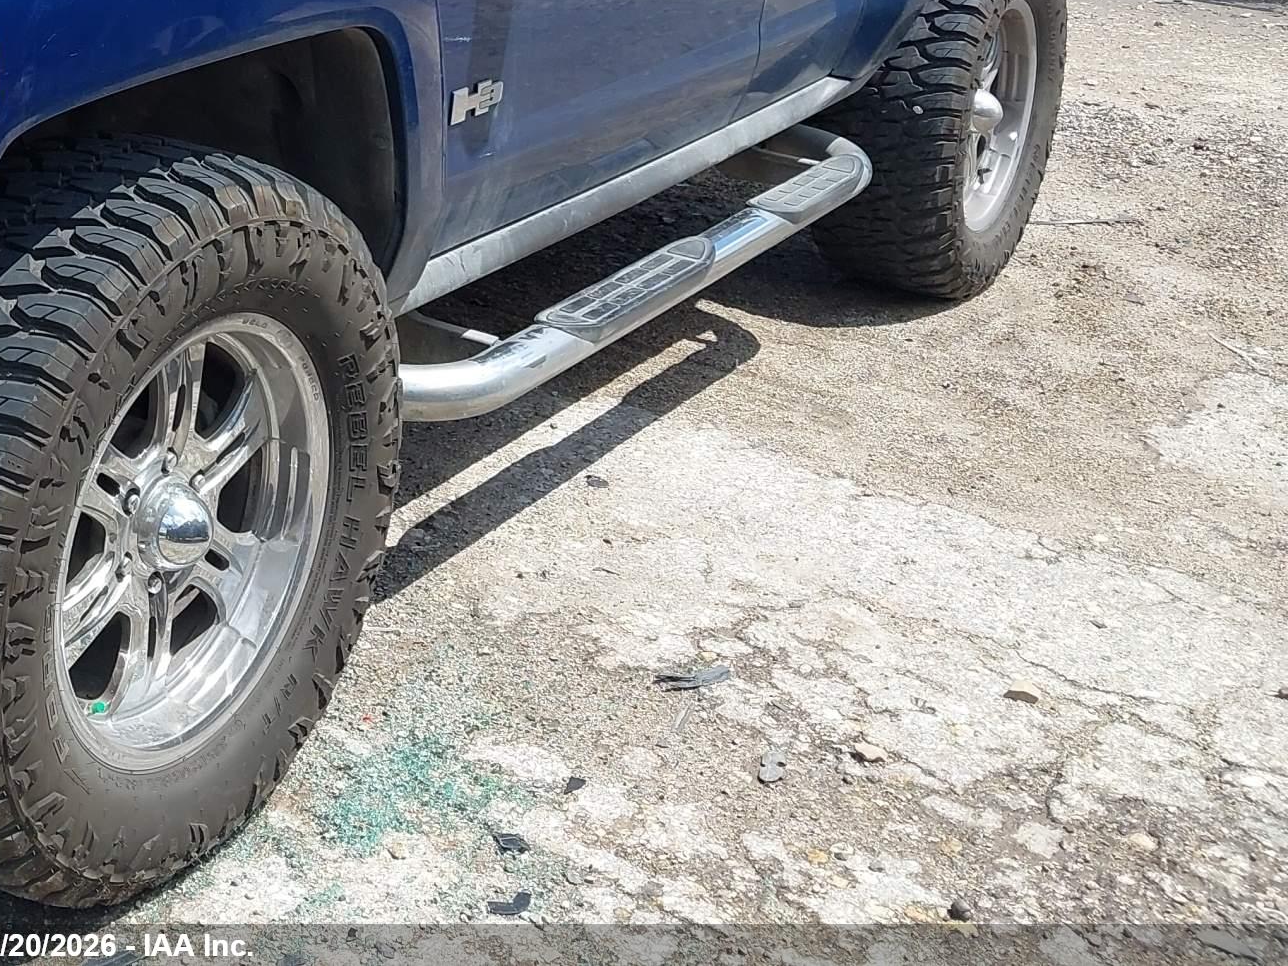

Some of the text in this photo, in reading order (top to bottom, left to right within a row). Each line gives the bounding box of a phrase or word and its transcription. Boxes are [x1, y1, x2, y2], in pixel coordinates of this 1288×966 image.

[450, 79, 504, 126] H3
[337, 353, 369, 503] REBEL
[301, 515, 361, 660] HAWK
